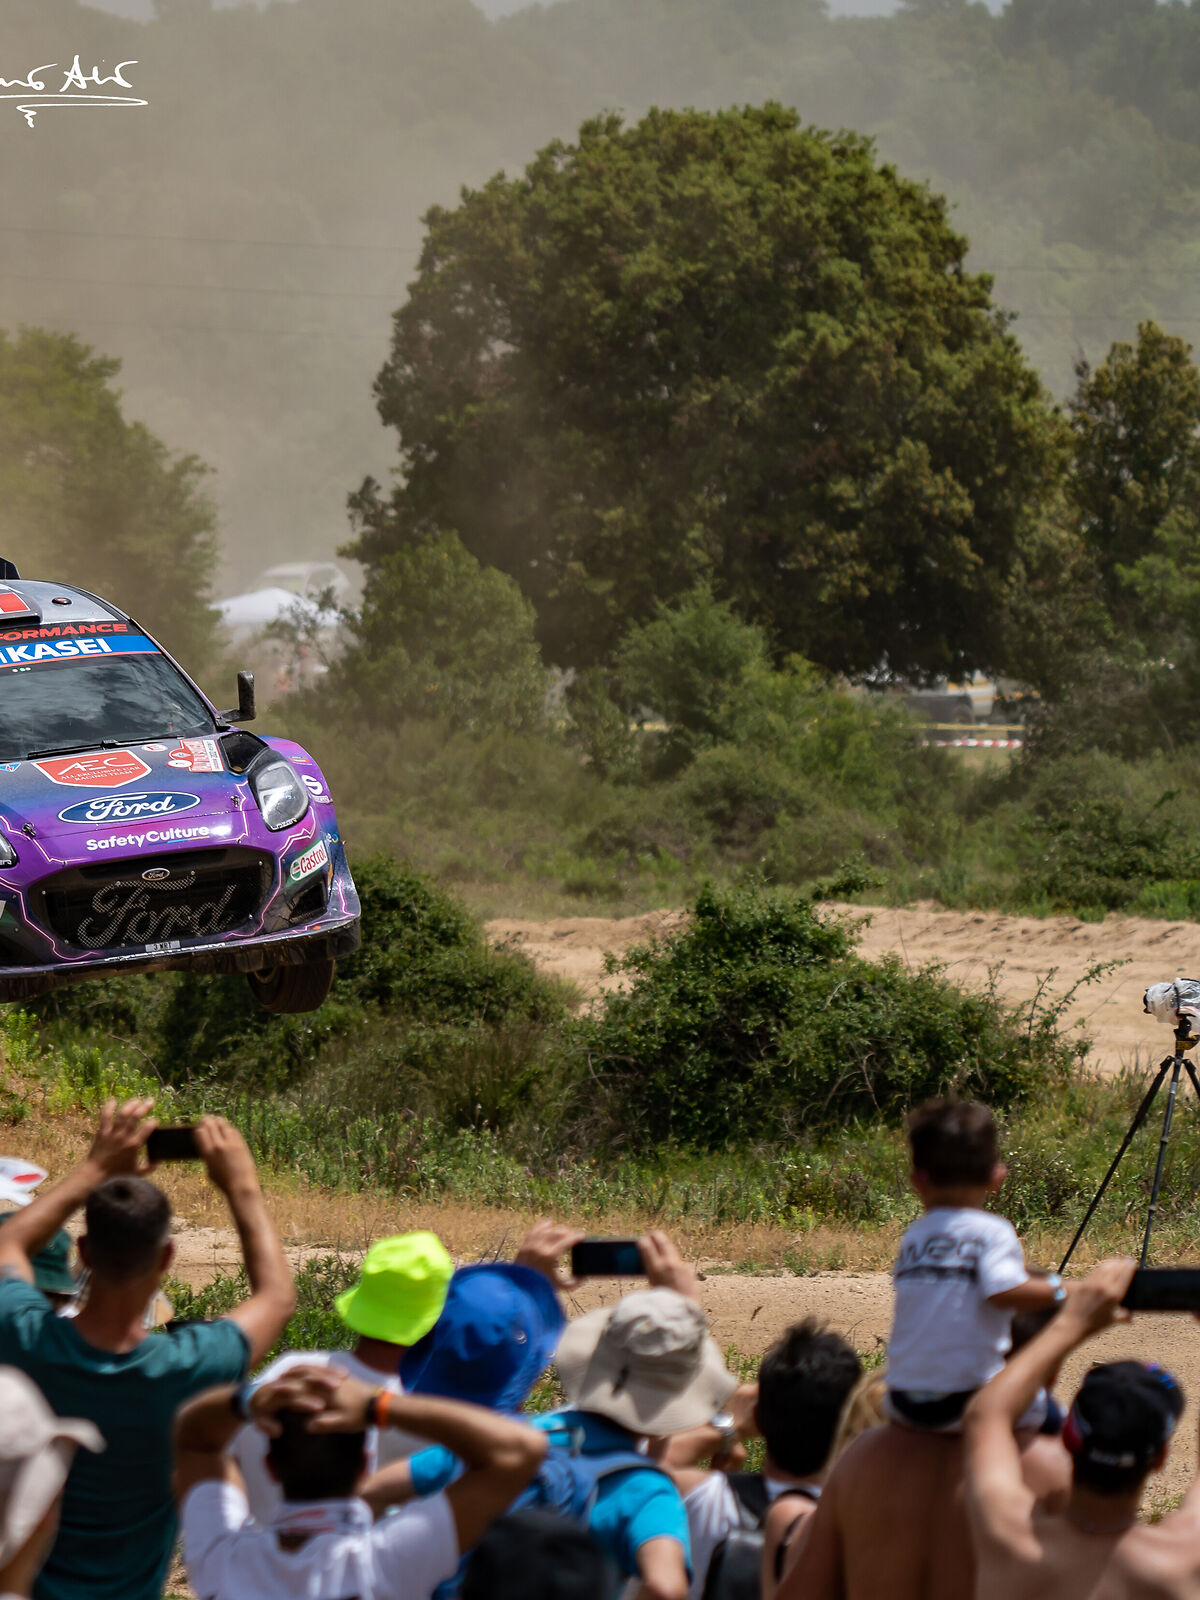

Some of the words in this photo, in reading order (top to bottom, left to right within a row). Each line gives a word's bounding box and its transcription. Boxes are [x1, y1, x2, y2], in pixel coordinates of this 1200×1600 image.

[57, 757, 136, 776] AEC
[108, 770, 134, 778] TEAM
[85, 794, 177, 821] Ford
[86, 826, 210, 851] SafetyCulture
[300, 844, 327, 874] Castrol
[77, 880, 239, 949] Ford
